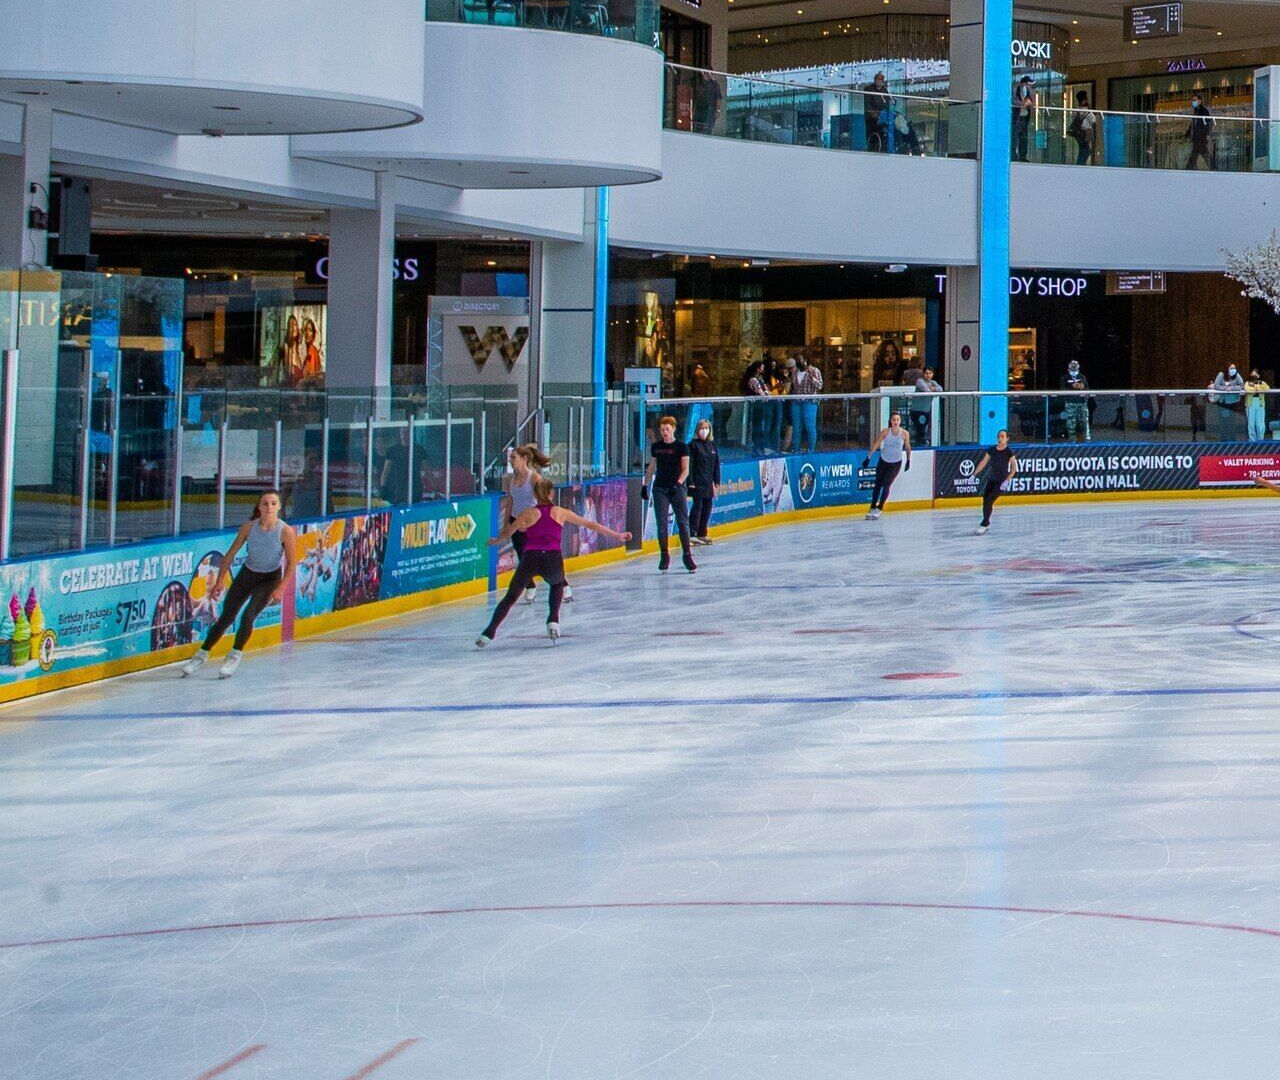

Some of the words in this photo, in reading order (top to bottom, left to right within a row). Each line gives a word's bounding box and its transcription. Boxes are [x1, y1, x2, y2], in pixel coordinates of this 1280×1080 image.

[1011, 39, 1051, 59] OVSKI
[1167, 58, 1206, 72] ZARA
[1009, 276, 1034, 295] DY
[1038, 276, 1087, 296] SHOP
[1008, 457, 1057, 473] AYFIELD
[1059, 457, 1105, 471] TOYOTA
[1107, 456, 1118, 470] IS
[1121, 455, 1171, 470] COMING
[1174, 455, 1193, 469] TO
[1223, 458, 1244, 467] VALET
[1244, 457, 1274, 466] PARKING
[821, 479, 851, 489] REWARDS
[954, 478, 980, 486] MAYFIELD
[1035, 475, 1104, 491] EDMONTON
[1108, 475, 1140, 488] MALL
[956, 486, 977, 494] TOYOTA
[58, 560, 140, 594] CELEBRATE
[141, 557, 160, 580] AT
[162, 551, 194, 578] WEM
[58, 611, 84, 625] Birthday
[58, 625, 82, 638] starting
[82, 623, 89, 632] at
[89, 621, 101, 633] just
